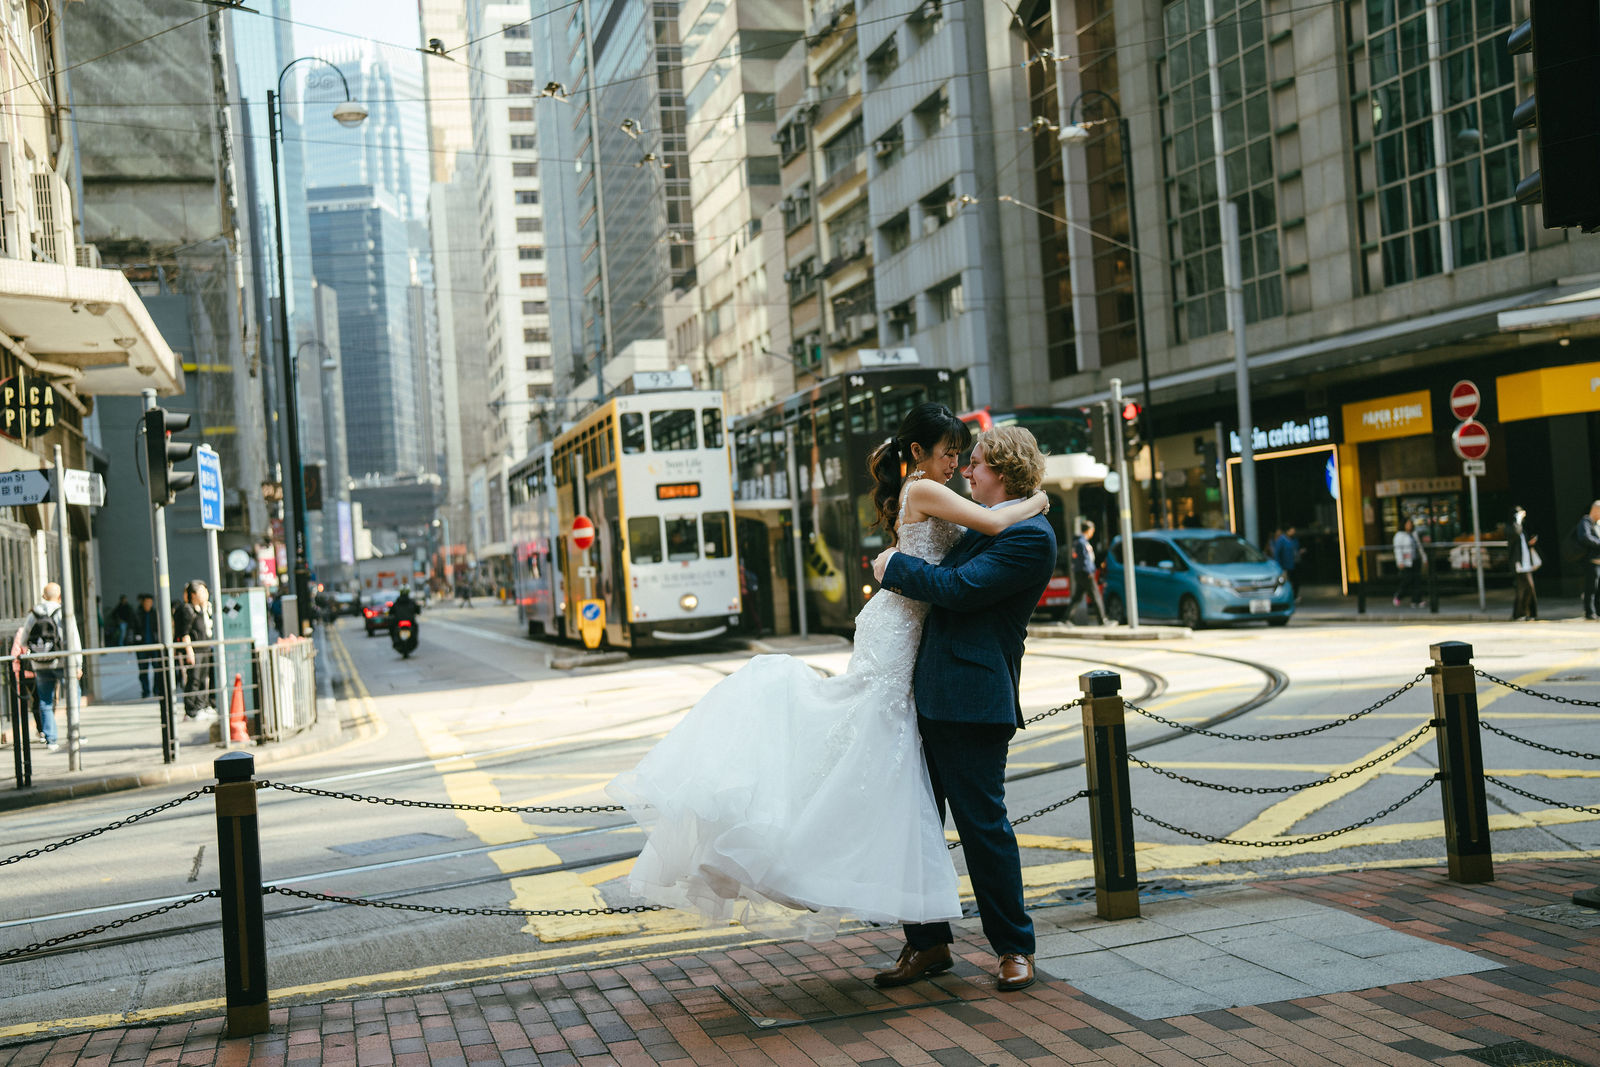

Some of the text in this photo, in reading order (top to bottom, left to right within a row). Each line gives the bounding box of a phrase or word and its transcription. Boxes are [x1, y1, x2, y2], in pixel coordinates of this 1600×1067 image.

[876, 351, 902, 363] 94
[650, 372, 674, 386] 93
[1268, 420, 1310, 447] coffee
[15, 474, 26, 482] St
